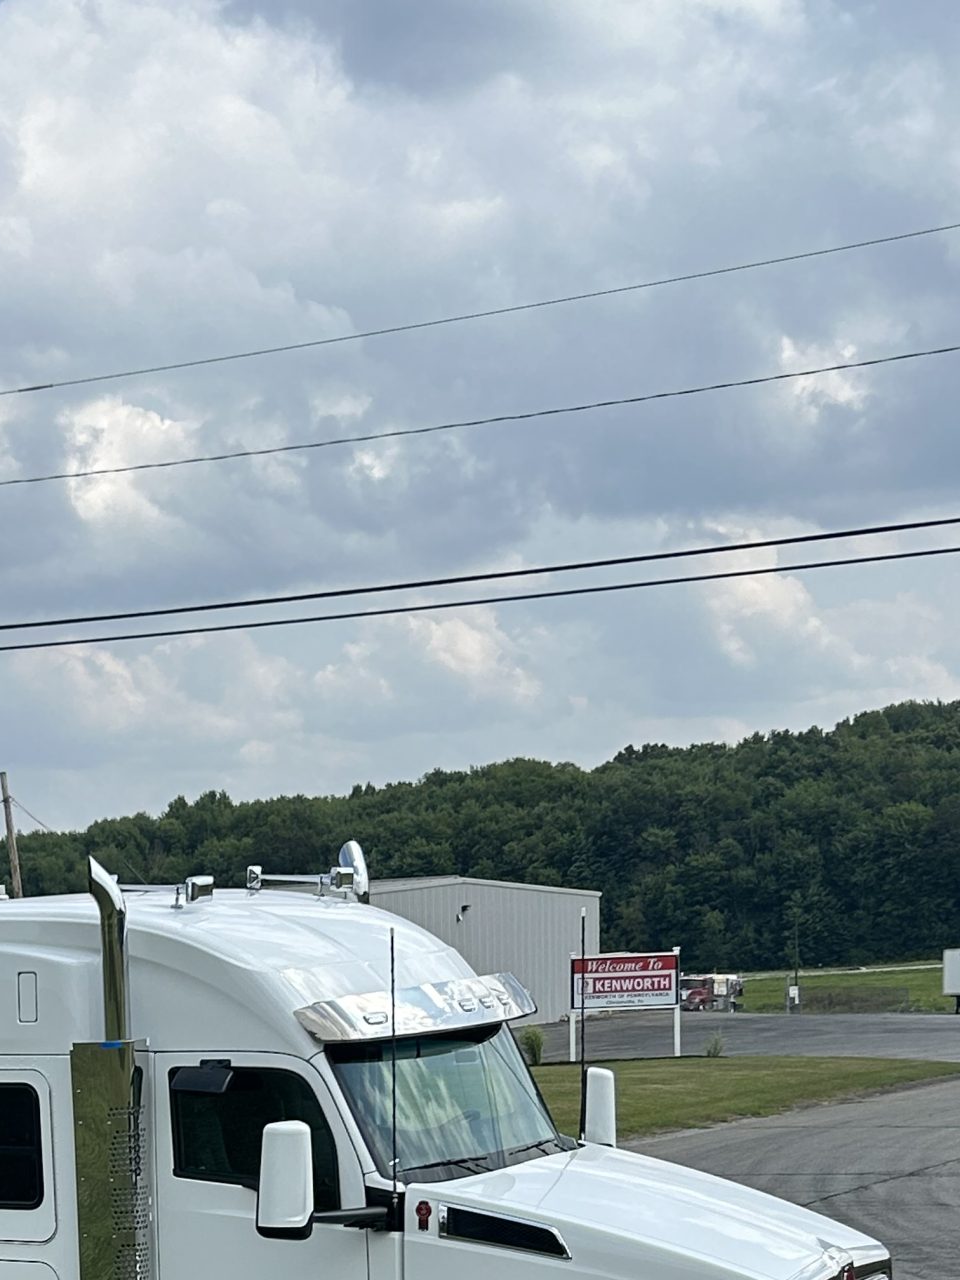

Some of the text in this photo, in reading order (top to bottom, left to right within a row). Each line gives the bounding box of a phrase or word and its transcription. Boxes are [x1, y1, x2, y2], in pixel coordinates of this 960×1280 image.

[587, 958, 662, 973] Welcome To
[596, 977, 669, 991] KENWORTH
